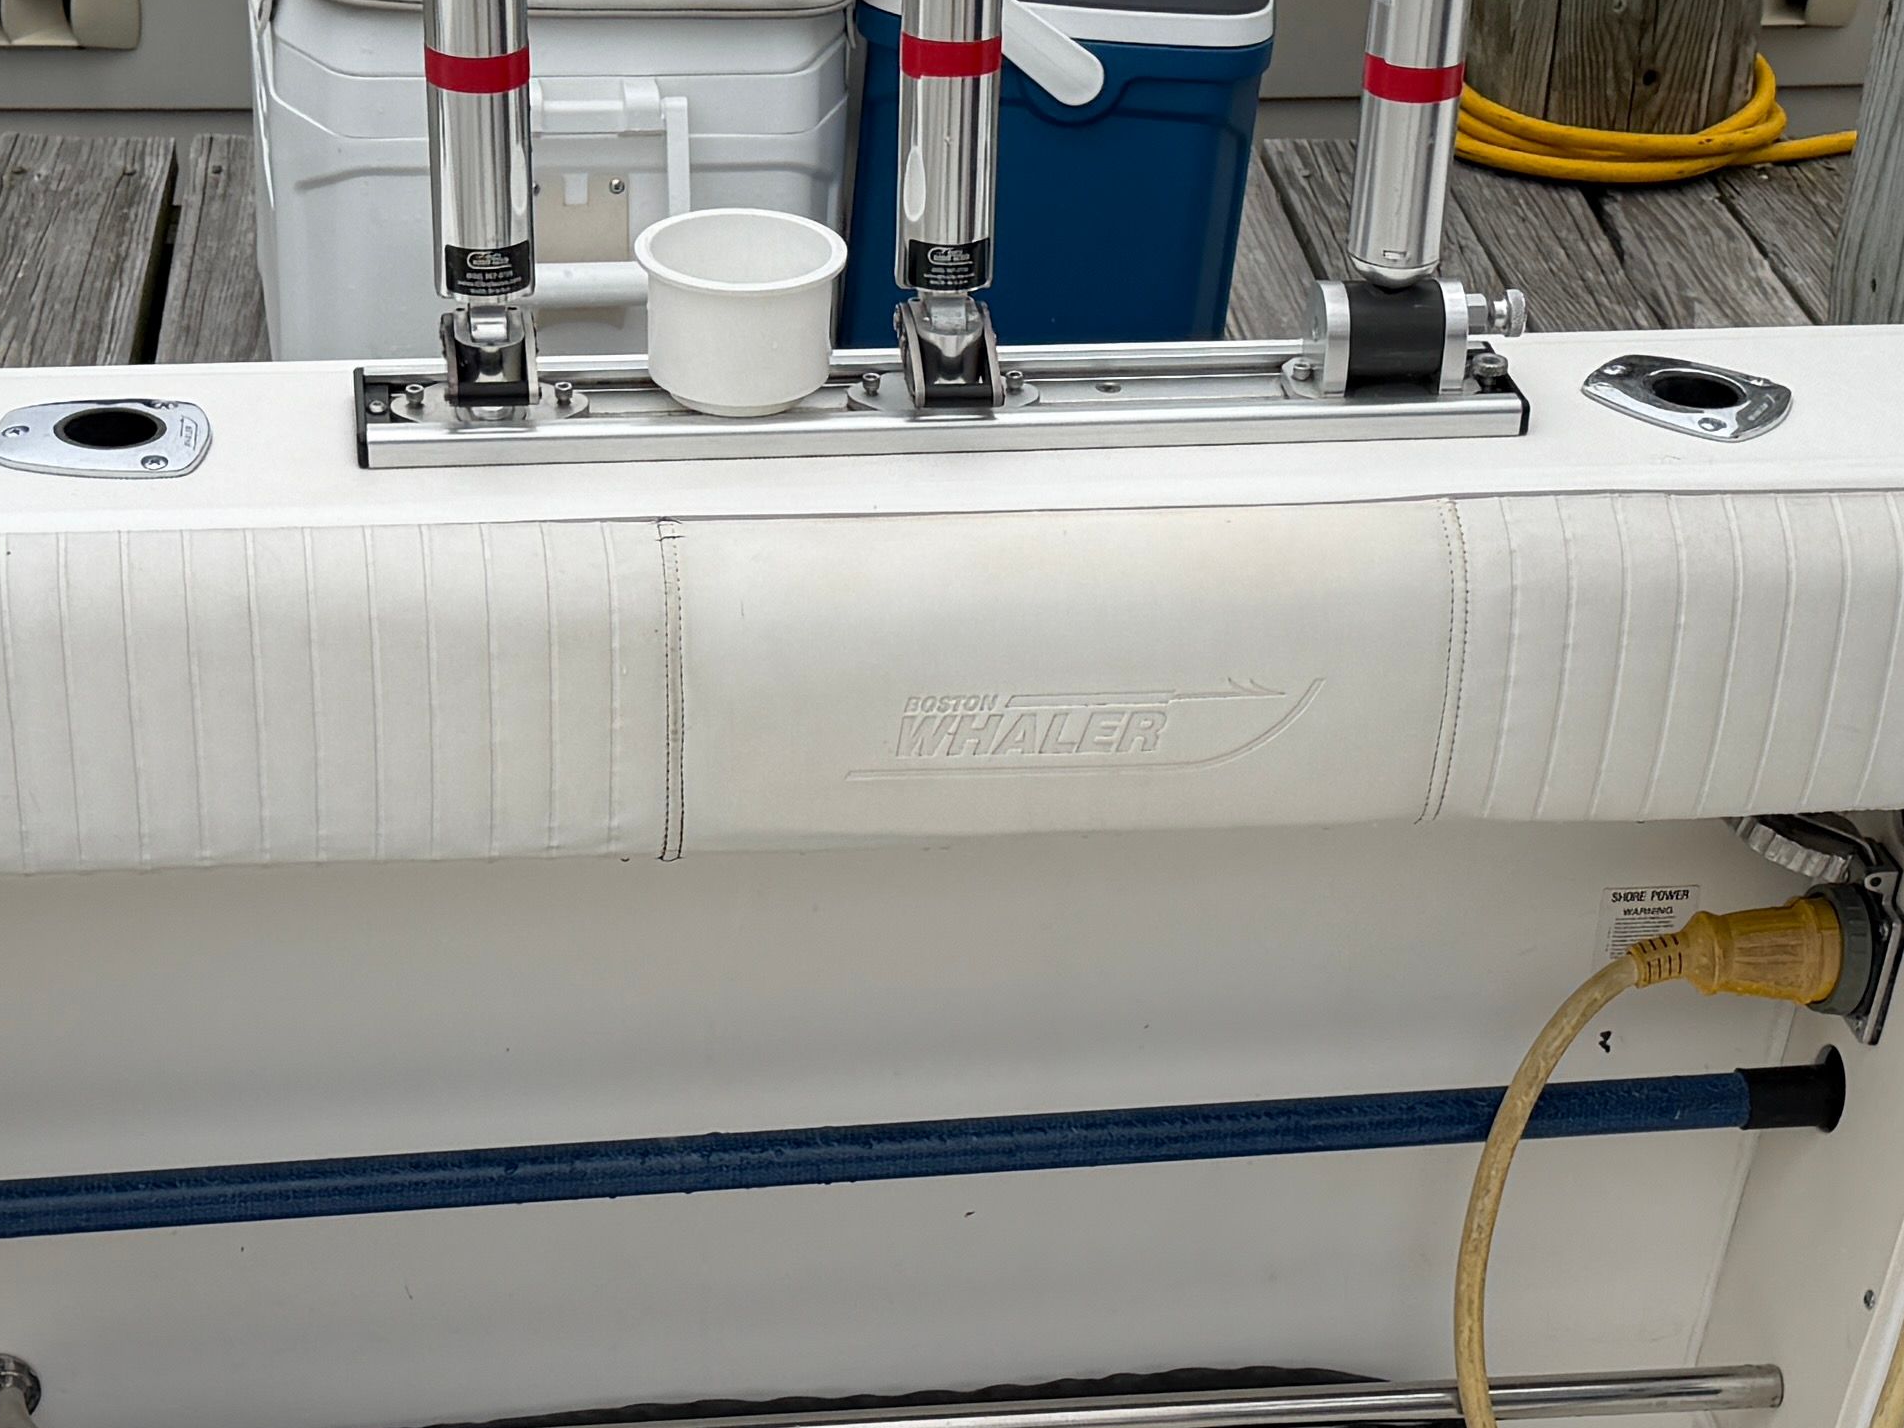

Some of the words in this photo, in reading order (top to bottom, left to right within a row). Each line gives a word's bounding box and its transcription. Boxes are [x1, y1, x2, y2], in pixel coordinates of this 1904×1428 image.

[904, 694, 998, 713] BOSTON
[896, 711, 1168, 757] WHALER
[1611, 890, 1647, 903] SHORE
[1650, 889, 1690, 902] POWER
[1623, 906, 1674, 916] WARNING
